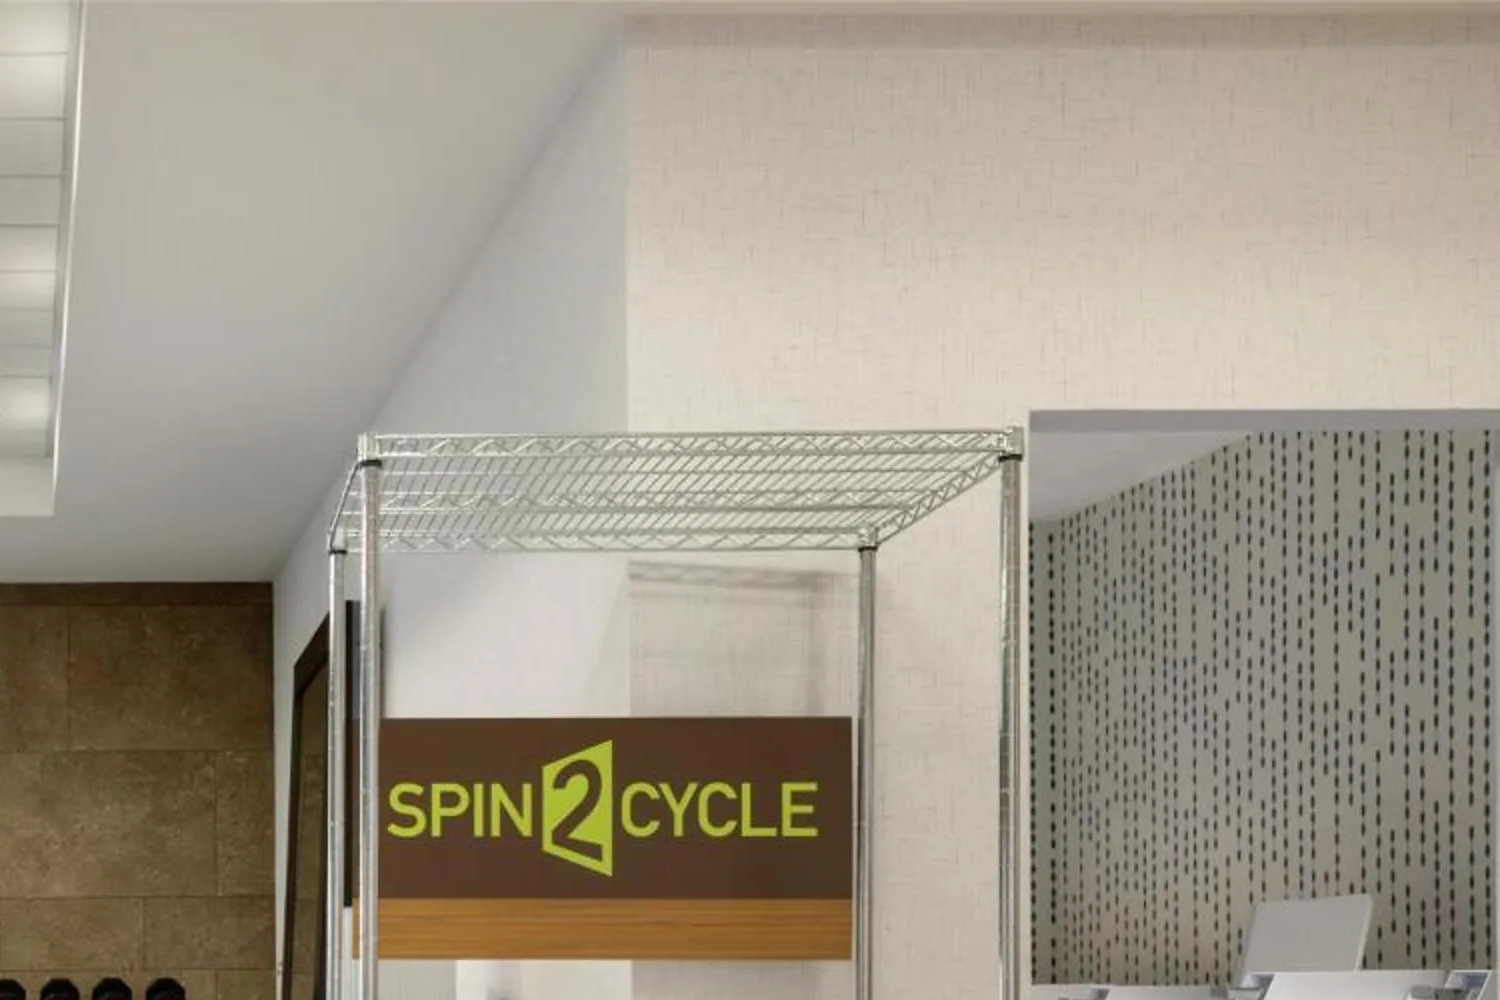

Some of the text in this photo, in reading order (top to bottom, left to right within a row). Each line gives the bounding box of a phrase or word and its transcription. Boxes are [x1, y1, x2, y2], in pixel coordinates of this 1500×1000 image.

[388, 759, 819, 862] SPIN 2 CYCLE
